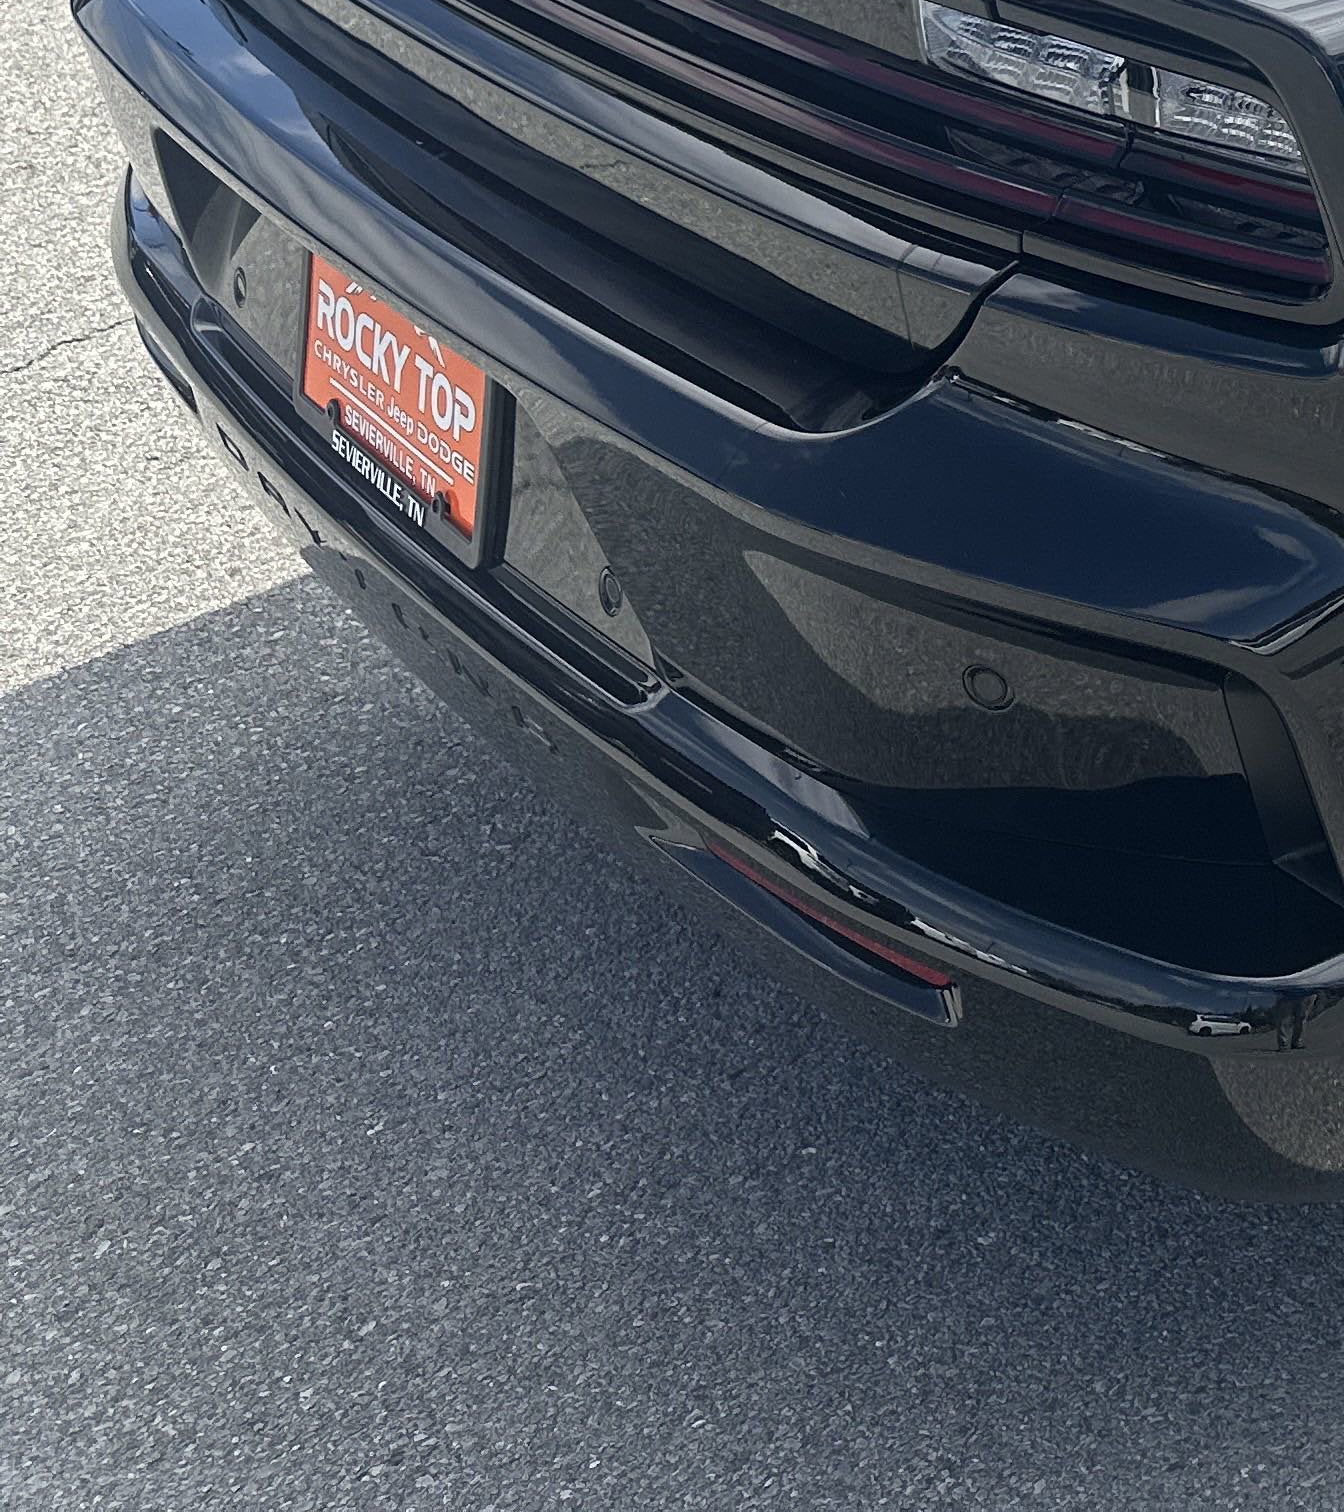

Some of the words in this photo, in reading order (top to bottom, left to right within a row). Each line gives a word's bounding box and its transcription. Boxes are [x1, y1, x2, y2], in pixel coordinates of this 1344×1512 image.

[314, 339, 385, 407] CHRYSLER
[386, 394, 415, 437] Jeep
[416, 422, 475, 485] DODGE
[317, 278, 411, 394] ROCKY
[413, 353, 477, 442] TOP
[331, 429, 404, 511] SEVIERVILLE,
[407, 497, 425, 528] TN
[344, 403, 417, 485] SEVIERVILLE,
[420, 471, 437, 498] TN
